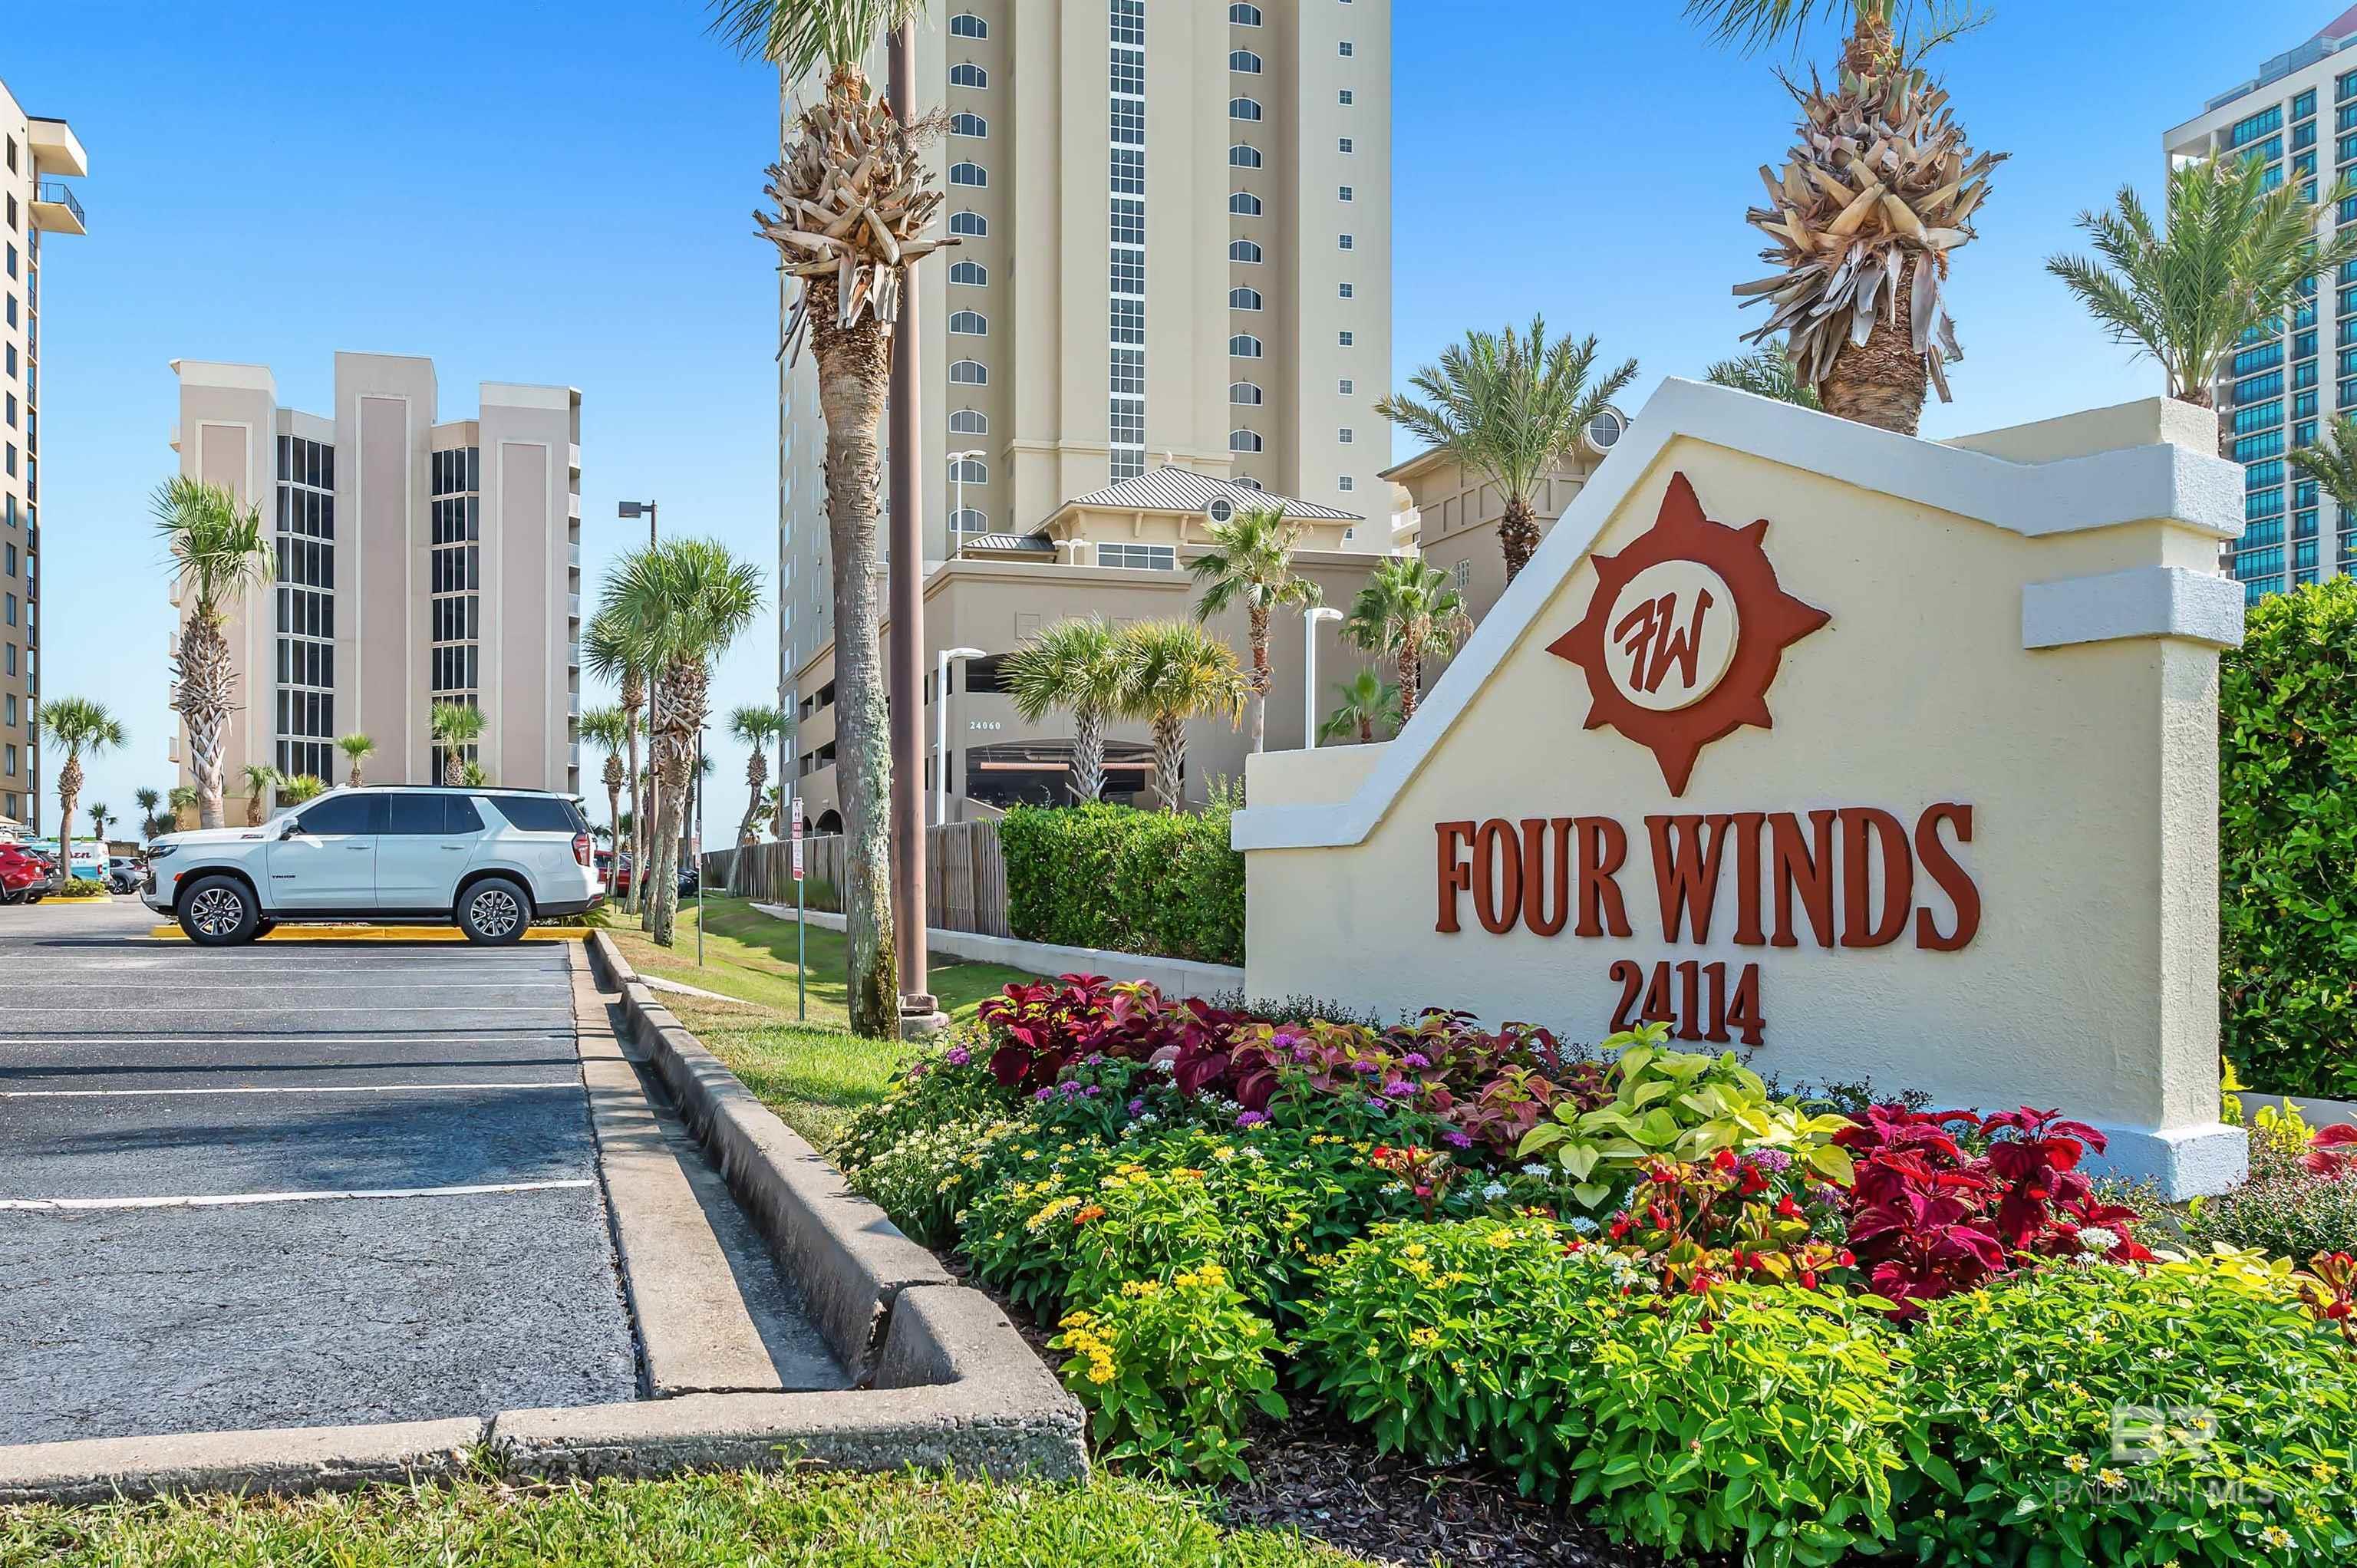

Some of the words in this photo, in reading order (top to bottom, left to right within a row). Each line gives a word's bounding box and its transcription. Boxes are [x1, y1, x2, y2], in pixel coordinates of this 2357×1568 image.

[1614, 588, 1714, 694] FW
[970, 721, 1001, 730] 24060
[1435, 815, 1633, 937] FOUR
[1643, 802, 1981, 951] WINDS
[1610, 960, 1765, 1046] 24114
